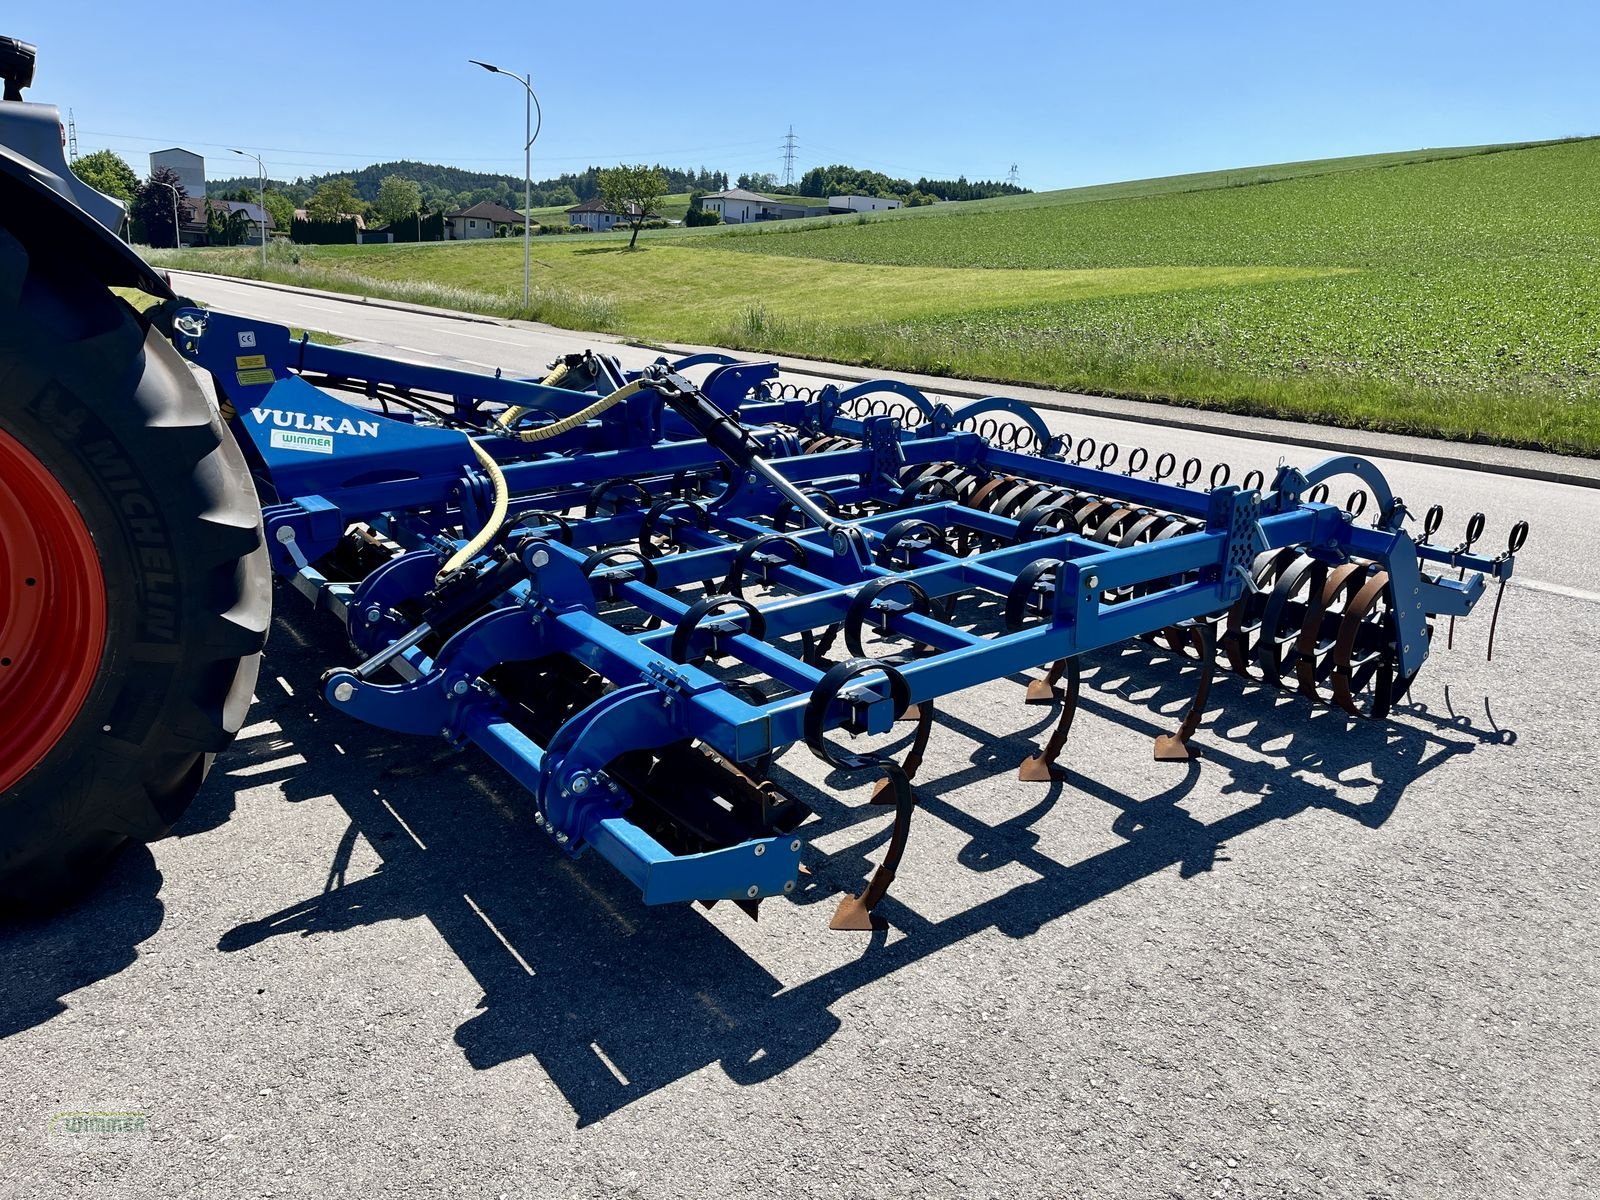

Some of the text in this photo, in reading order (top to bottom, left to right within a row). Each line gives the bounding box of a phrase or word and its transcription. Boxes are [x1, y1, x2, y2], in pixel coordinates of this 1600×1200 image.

[250, 408, 380, 438] VULKAN
[282, 433, 331, 447] WIMMER
[80, 437, 178, 641] MICHELIN
